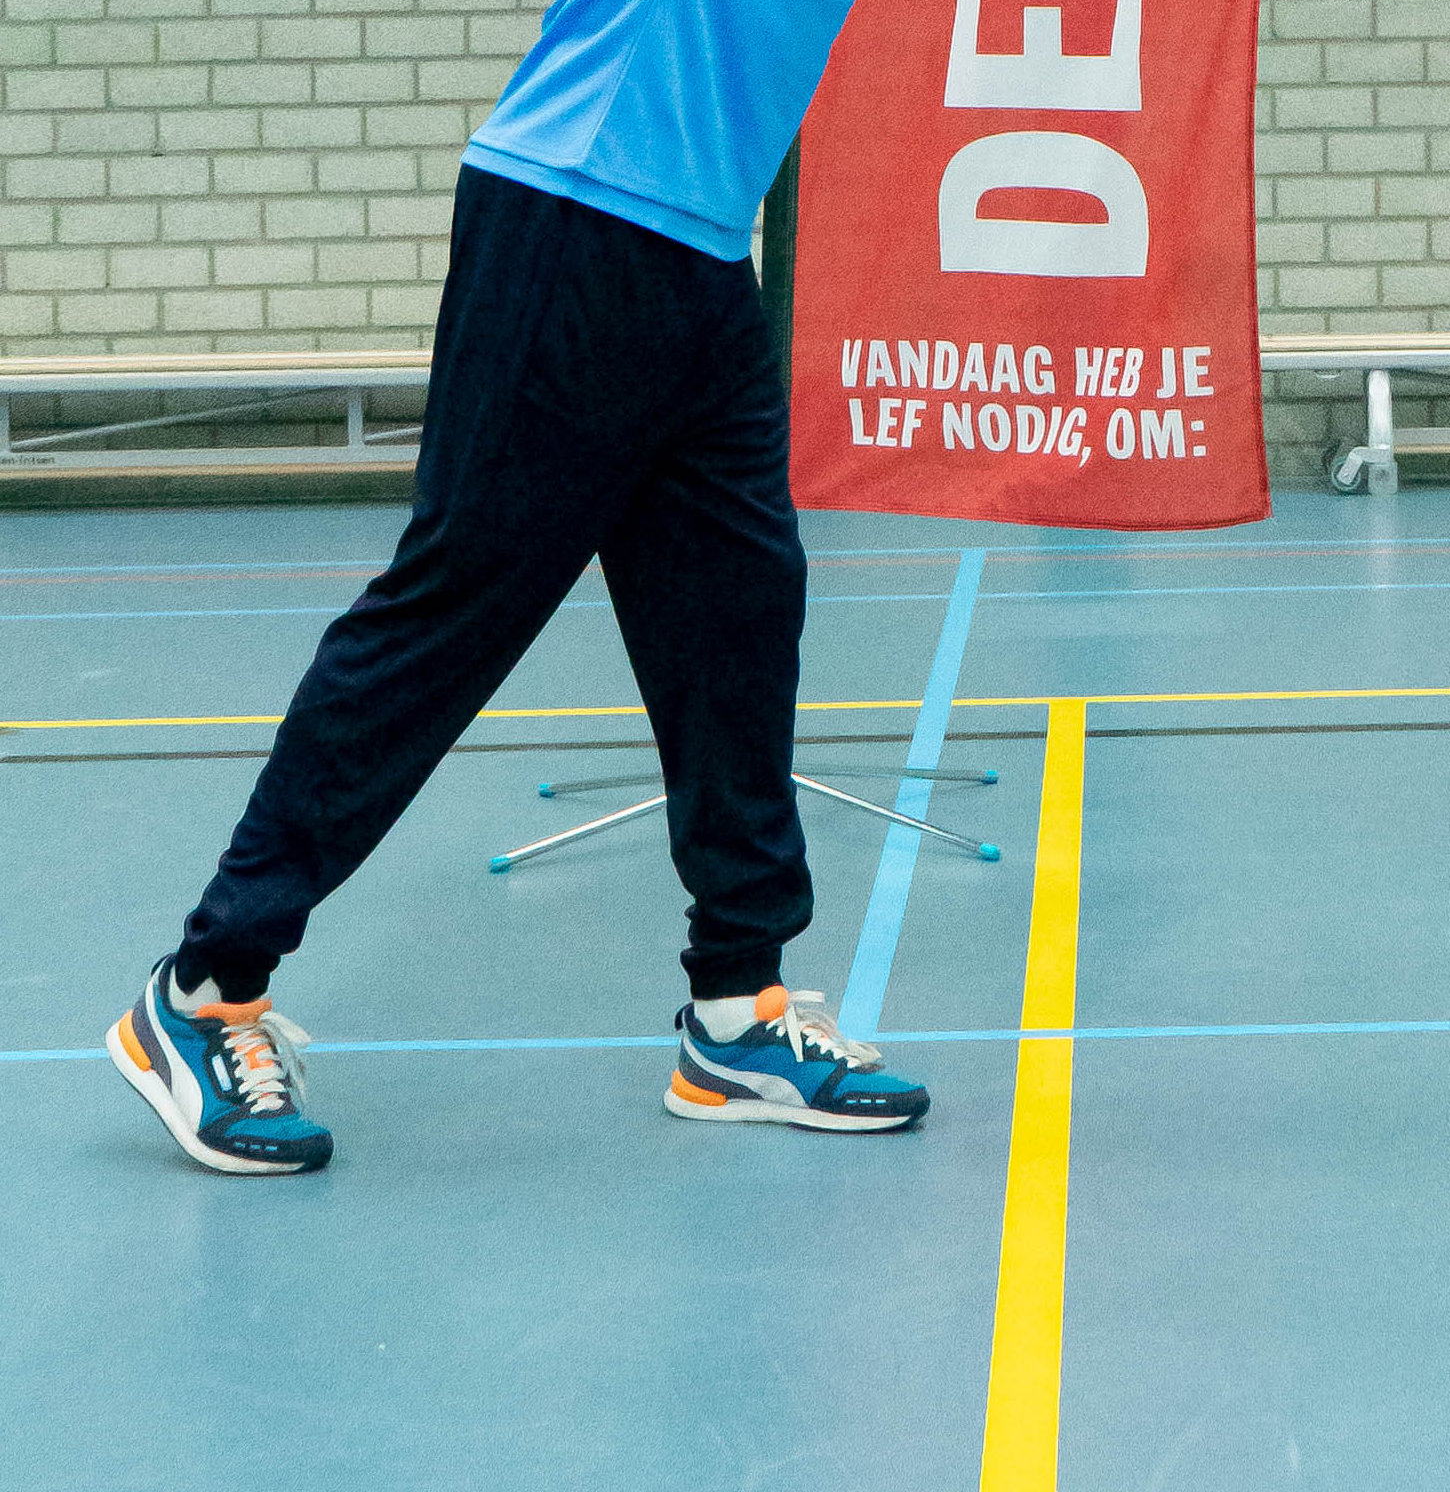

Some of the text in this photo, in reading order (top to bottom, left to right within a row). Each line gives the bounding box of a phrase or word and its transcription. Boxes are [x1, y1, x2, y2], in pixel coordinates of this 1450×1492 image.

[841, 339, 1214, 398] VANDAAG HEB JE
[848, 398, 1207, 468] LEF NODIG, OM:
